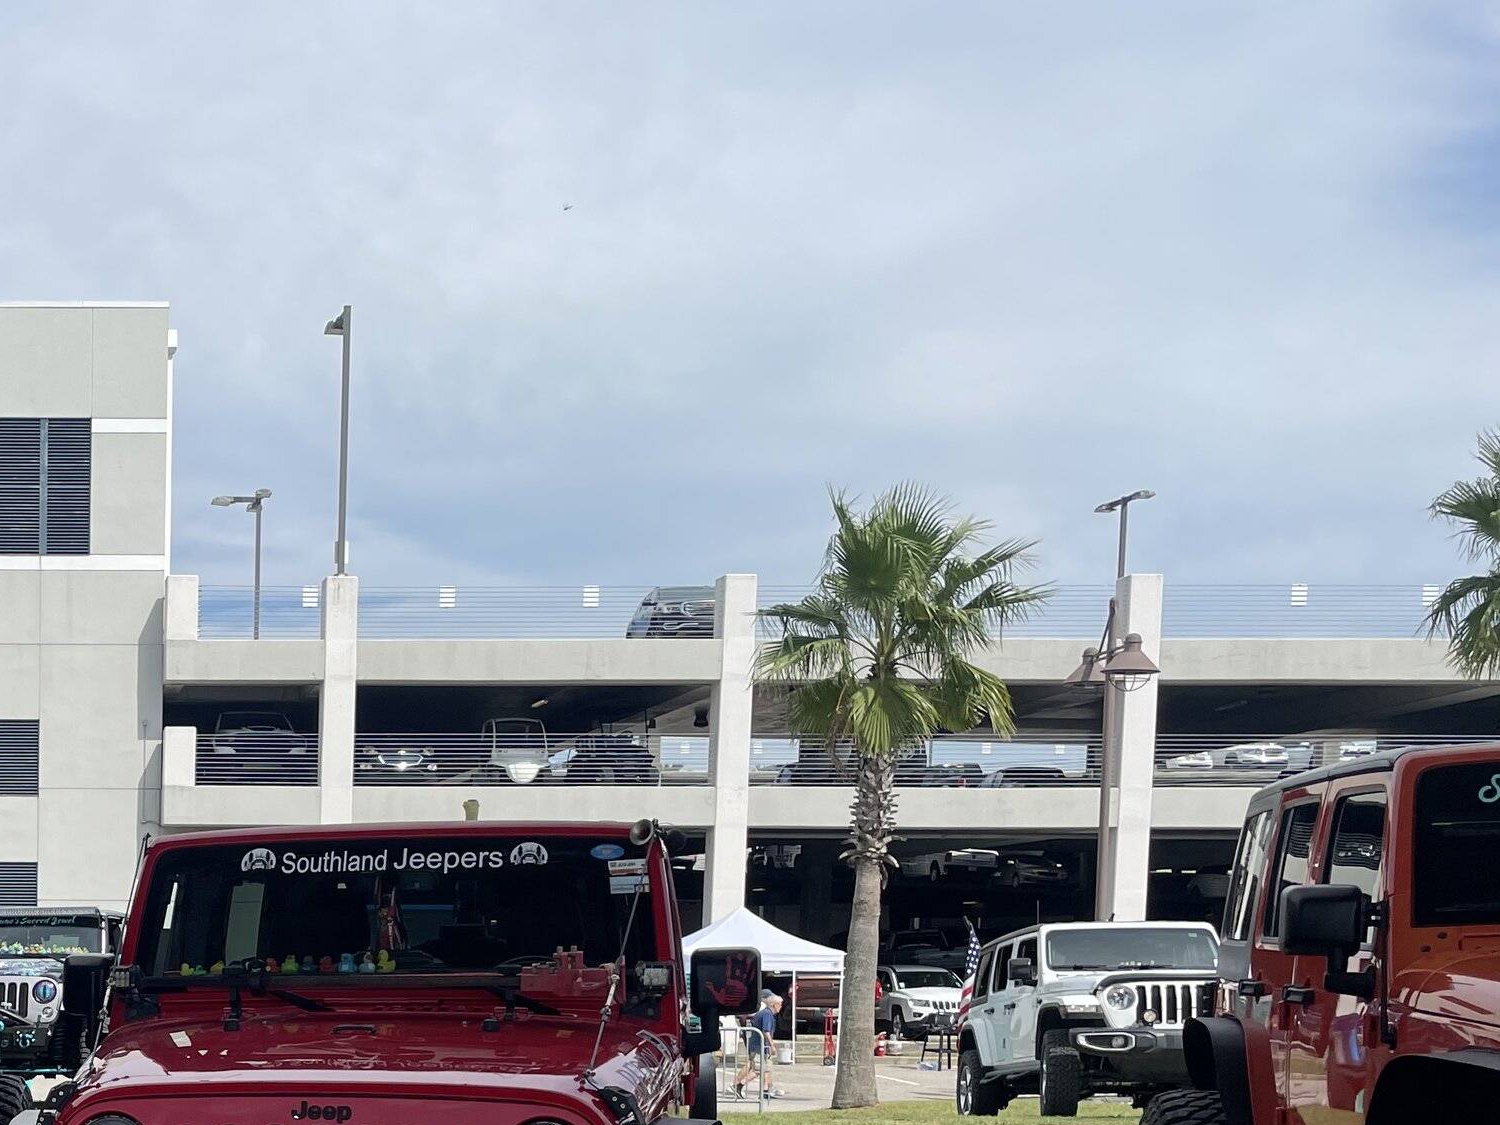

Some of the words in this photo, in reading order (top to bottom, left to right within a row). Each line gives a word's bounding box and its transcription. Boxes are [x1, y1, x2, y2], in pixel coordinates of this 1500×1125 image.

[281, 849, 388, 875] Southland
[393, 847, 504, 874] Jeepers
[291, 1100, 352, 1125] Jeep
